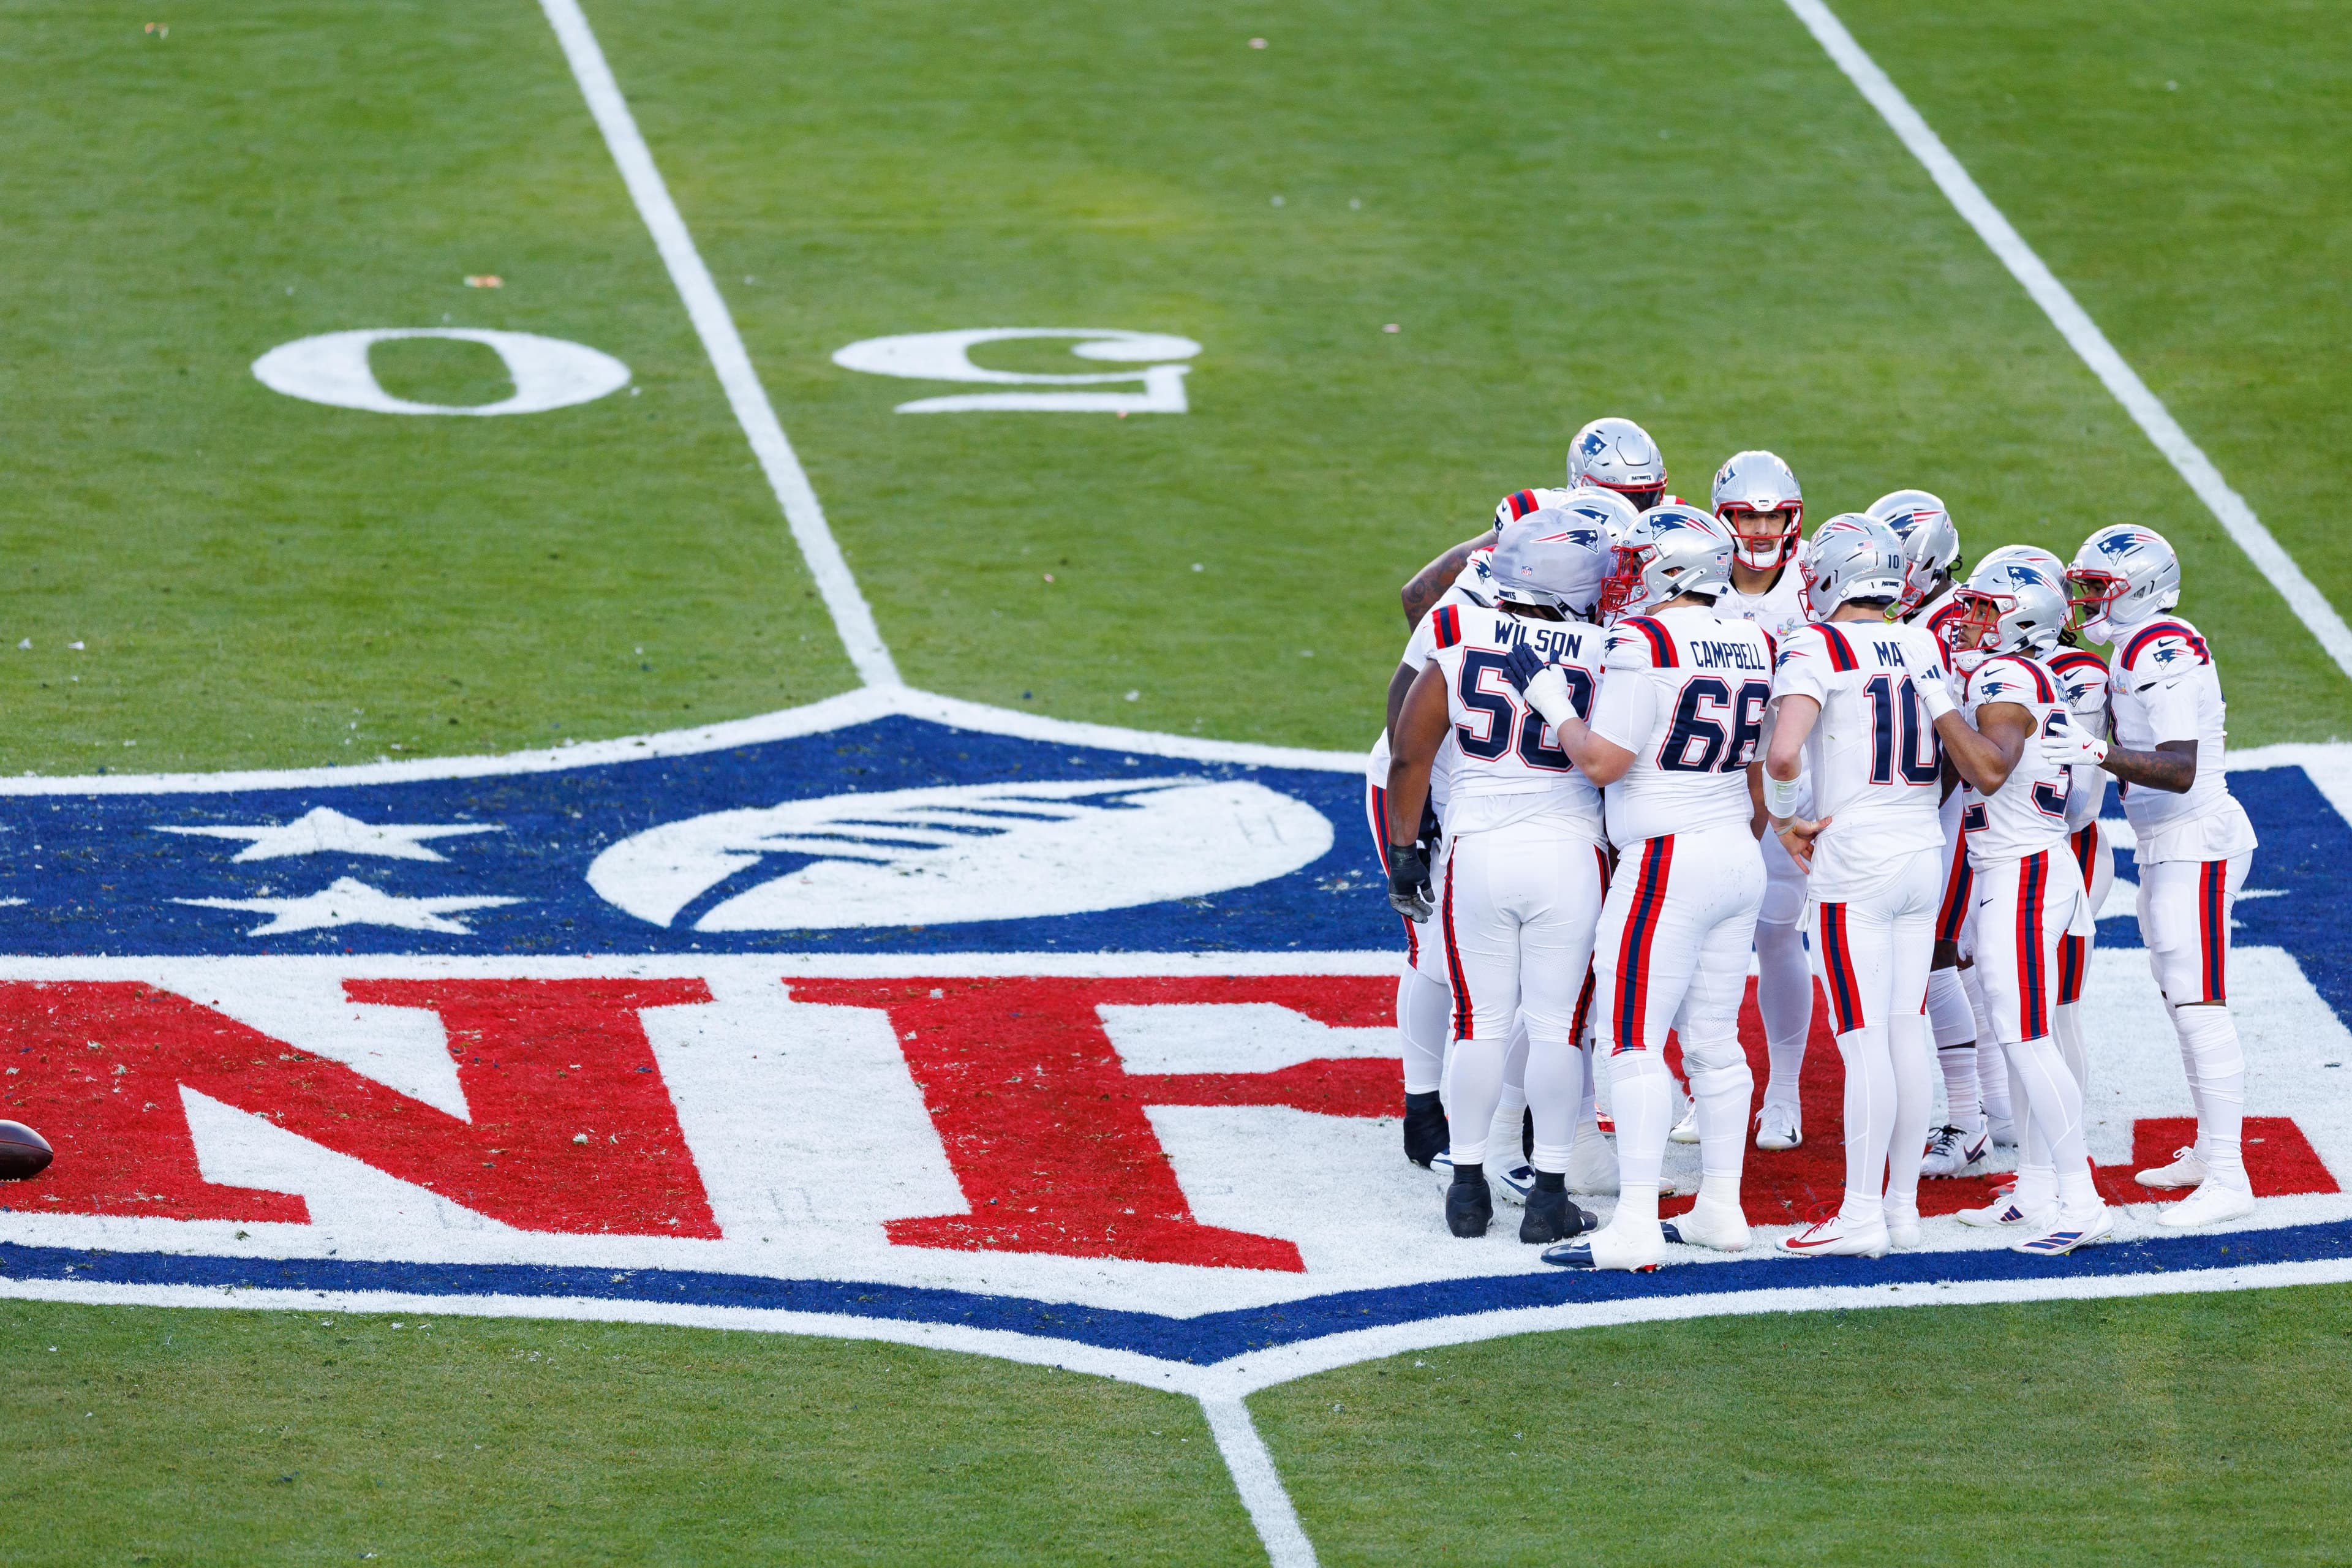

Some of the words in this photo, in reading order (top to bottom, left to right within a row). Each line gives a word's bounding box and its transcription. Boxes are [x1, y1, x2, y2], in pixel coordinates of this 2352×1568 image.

[1888, 554, 1899, 569] 10
[1494, 620, 1582, 659] WILSON
[1690, 641, 1765, 670] CAMPBELL
[1872, 641, 1905, 666] MA
[1455, 646, 1596, 772] 58
[1656, 675, 1772, 773] 66
[1863, 674, 1943, 786] 10
